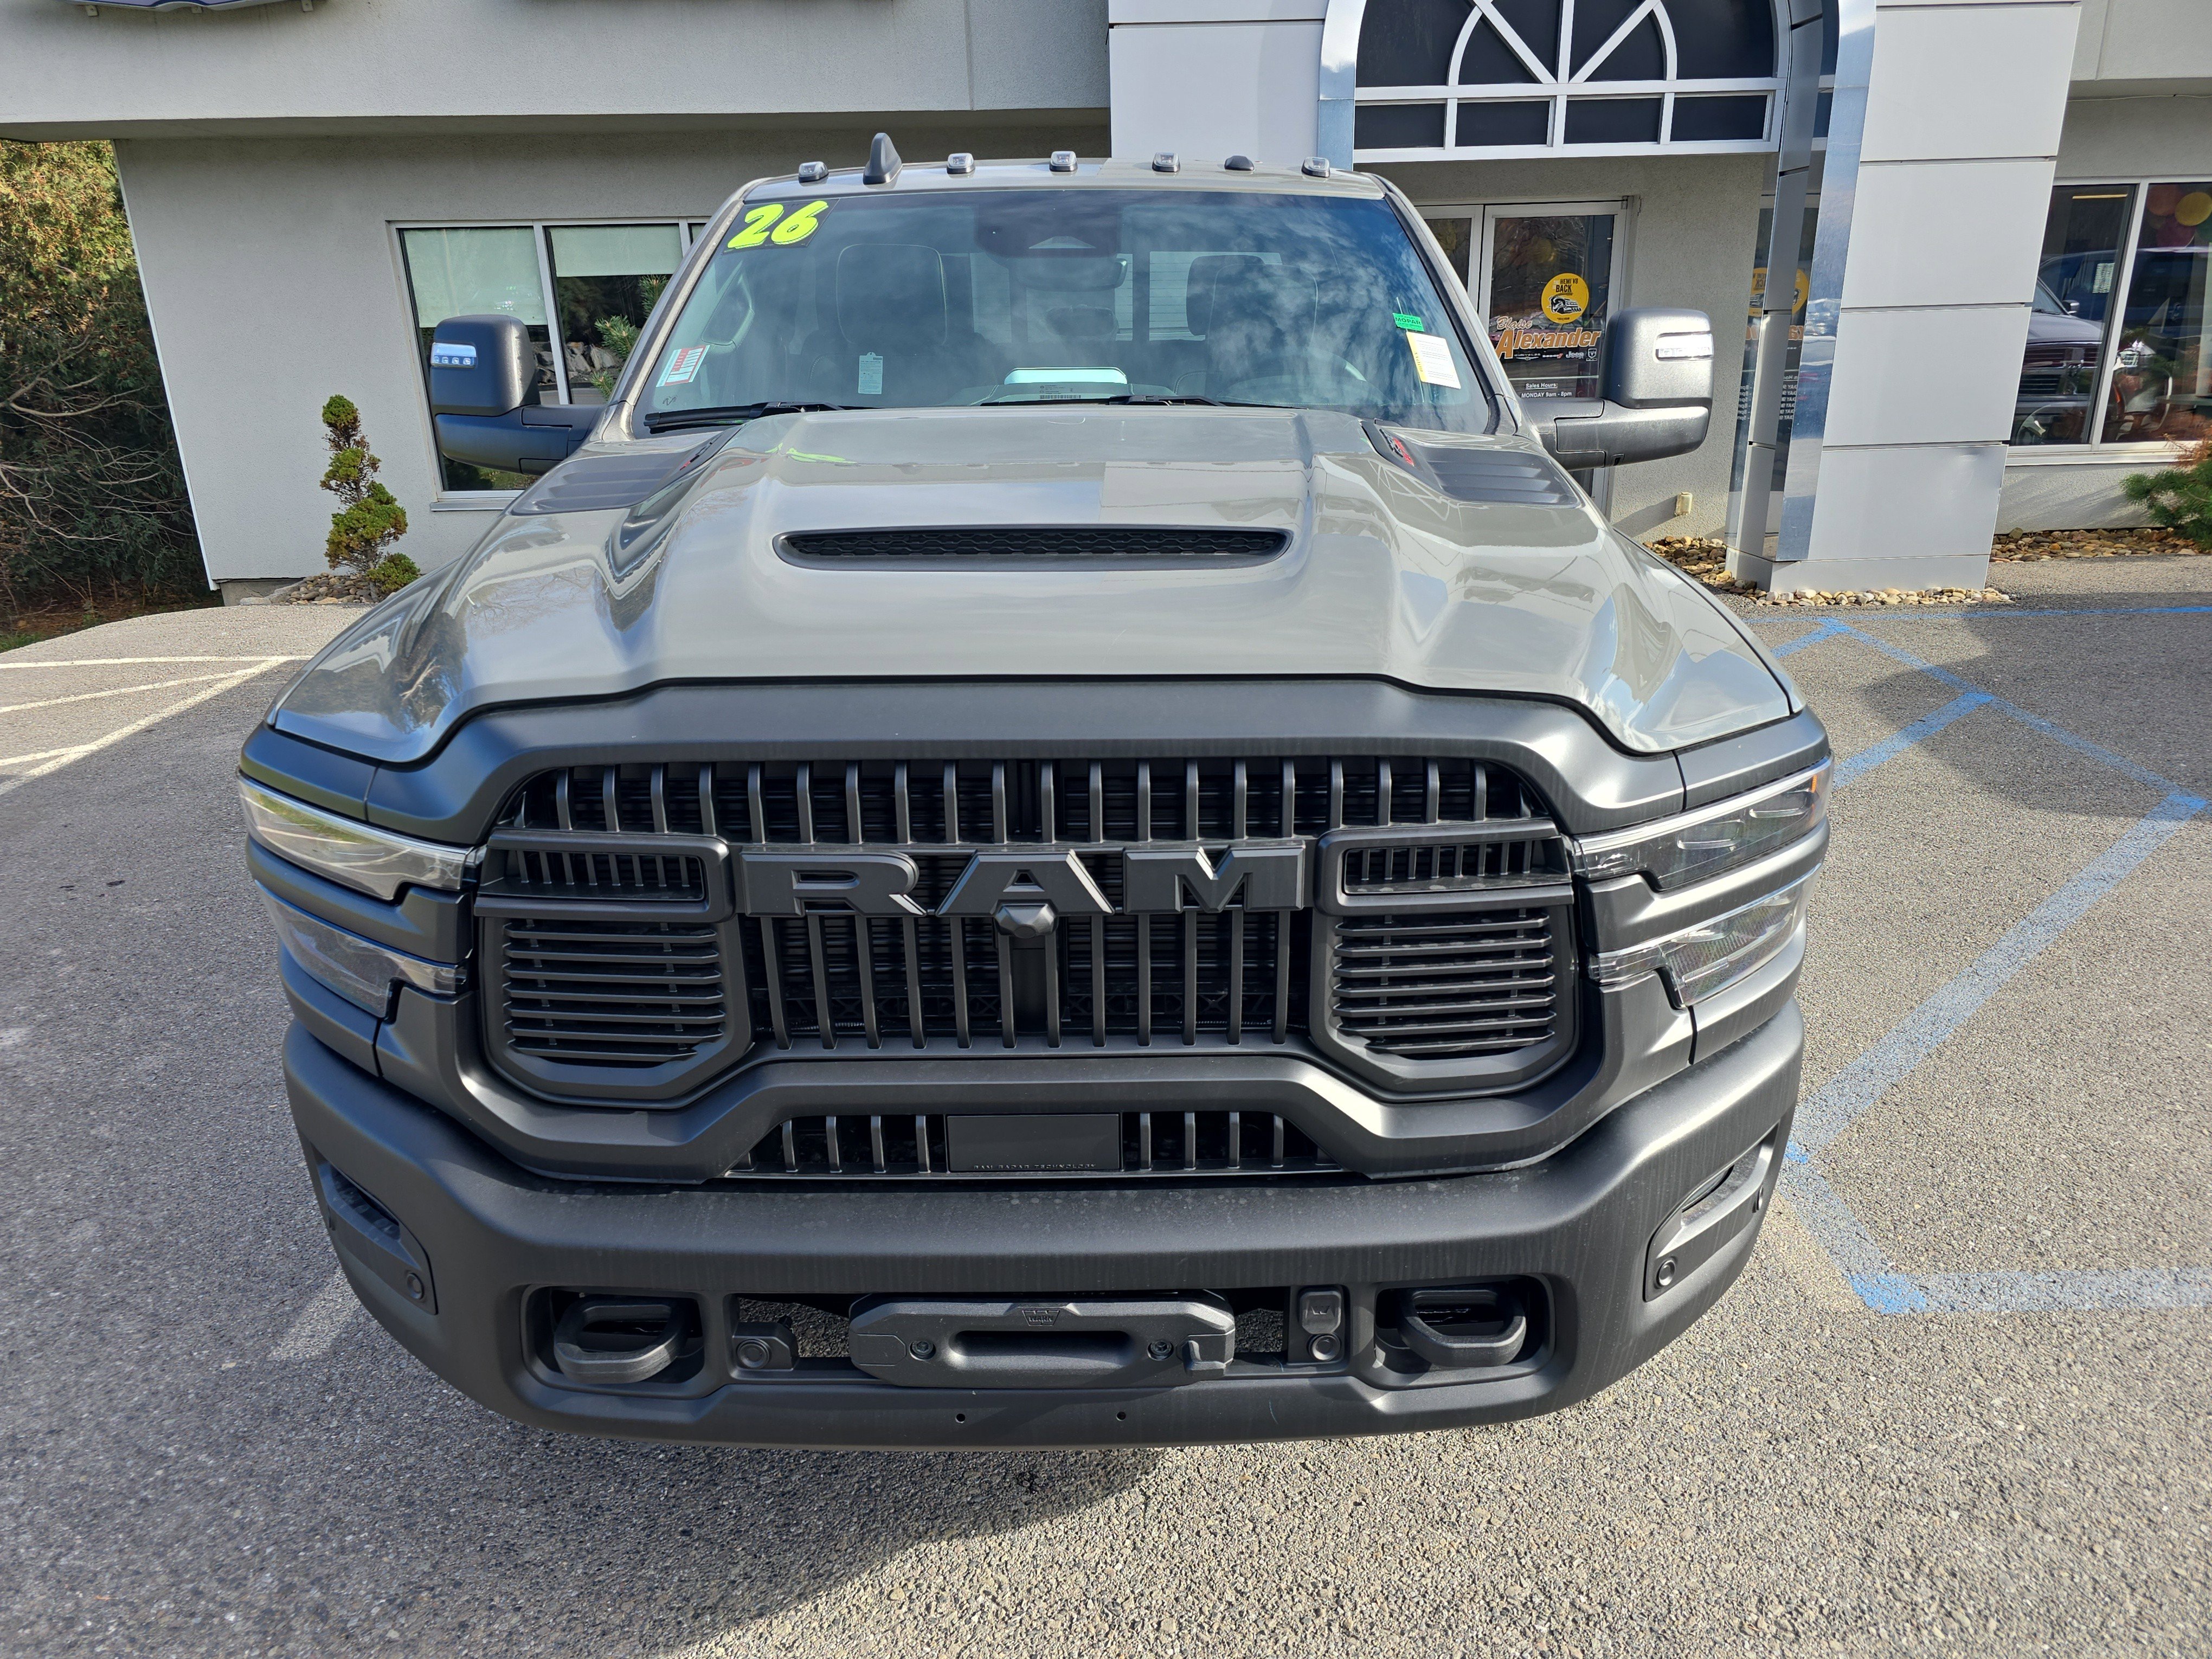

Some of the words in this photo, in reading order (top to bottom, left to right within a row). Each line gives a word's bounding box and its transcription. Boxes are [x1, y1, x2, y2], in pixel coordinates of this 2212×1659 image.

[728, 201, 828, 249] 26
[1495, 327, 1602, 359] Alexander
[1497, 316, 1533, 330] Blaise
[741, 845, 1306, 917] RAM
